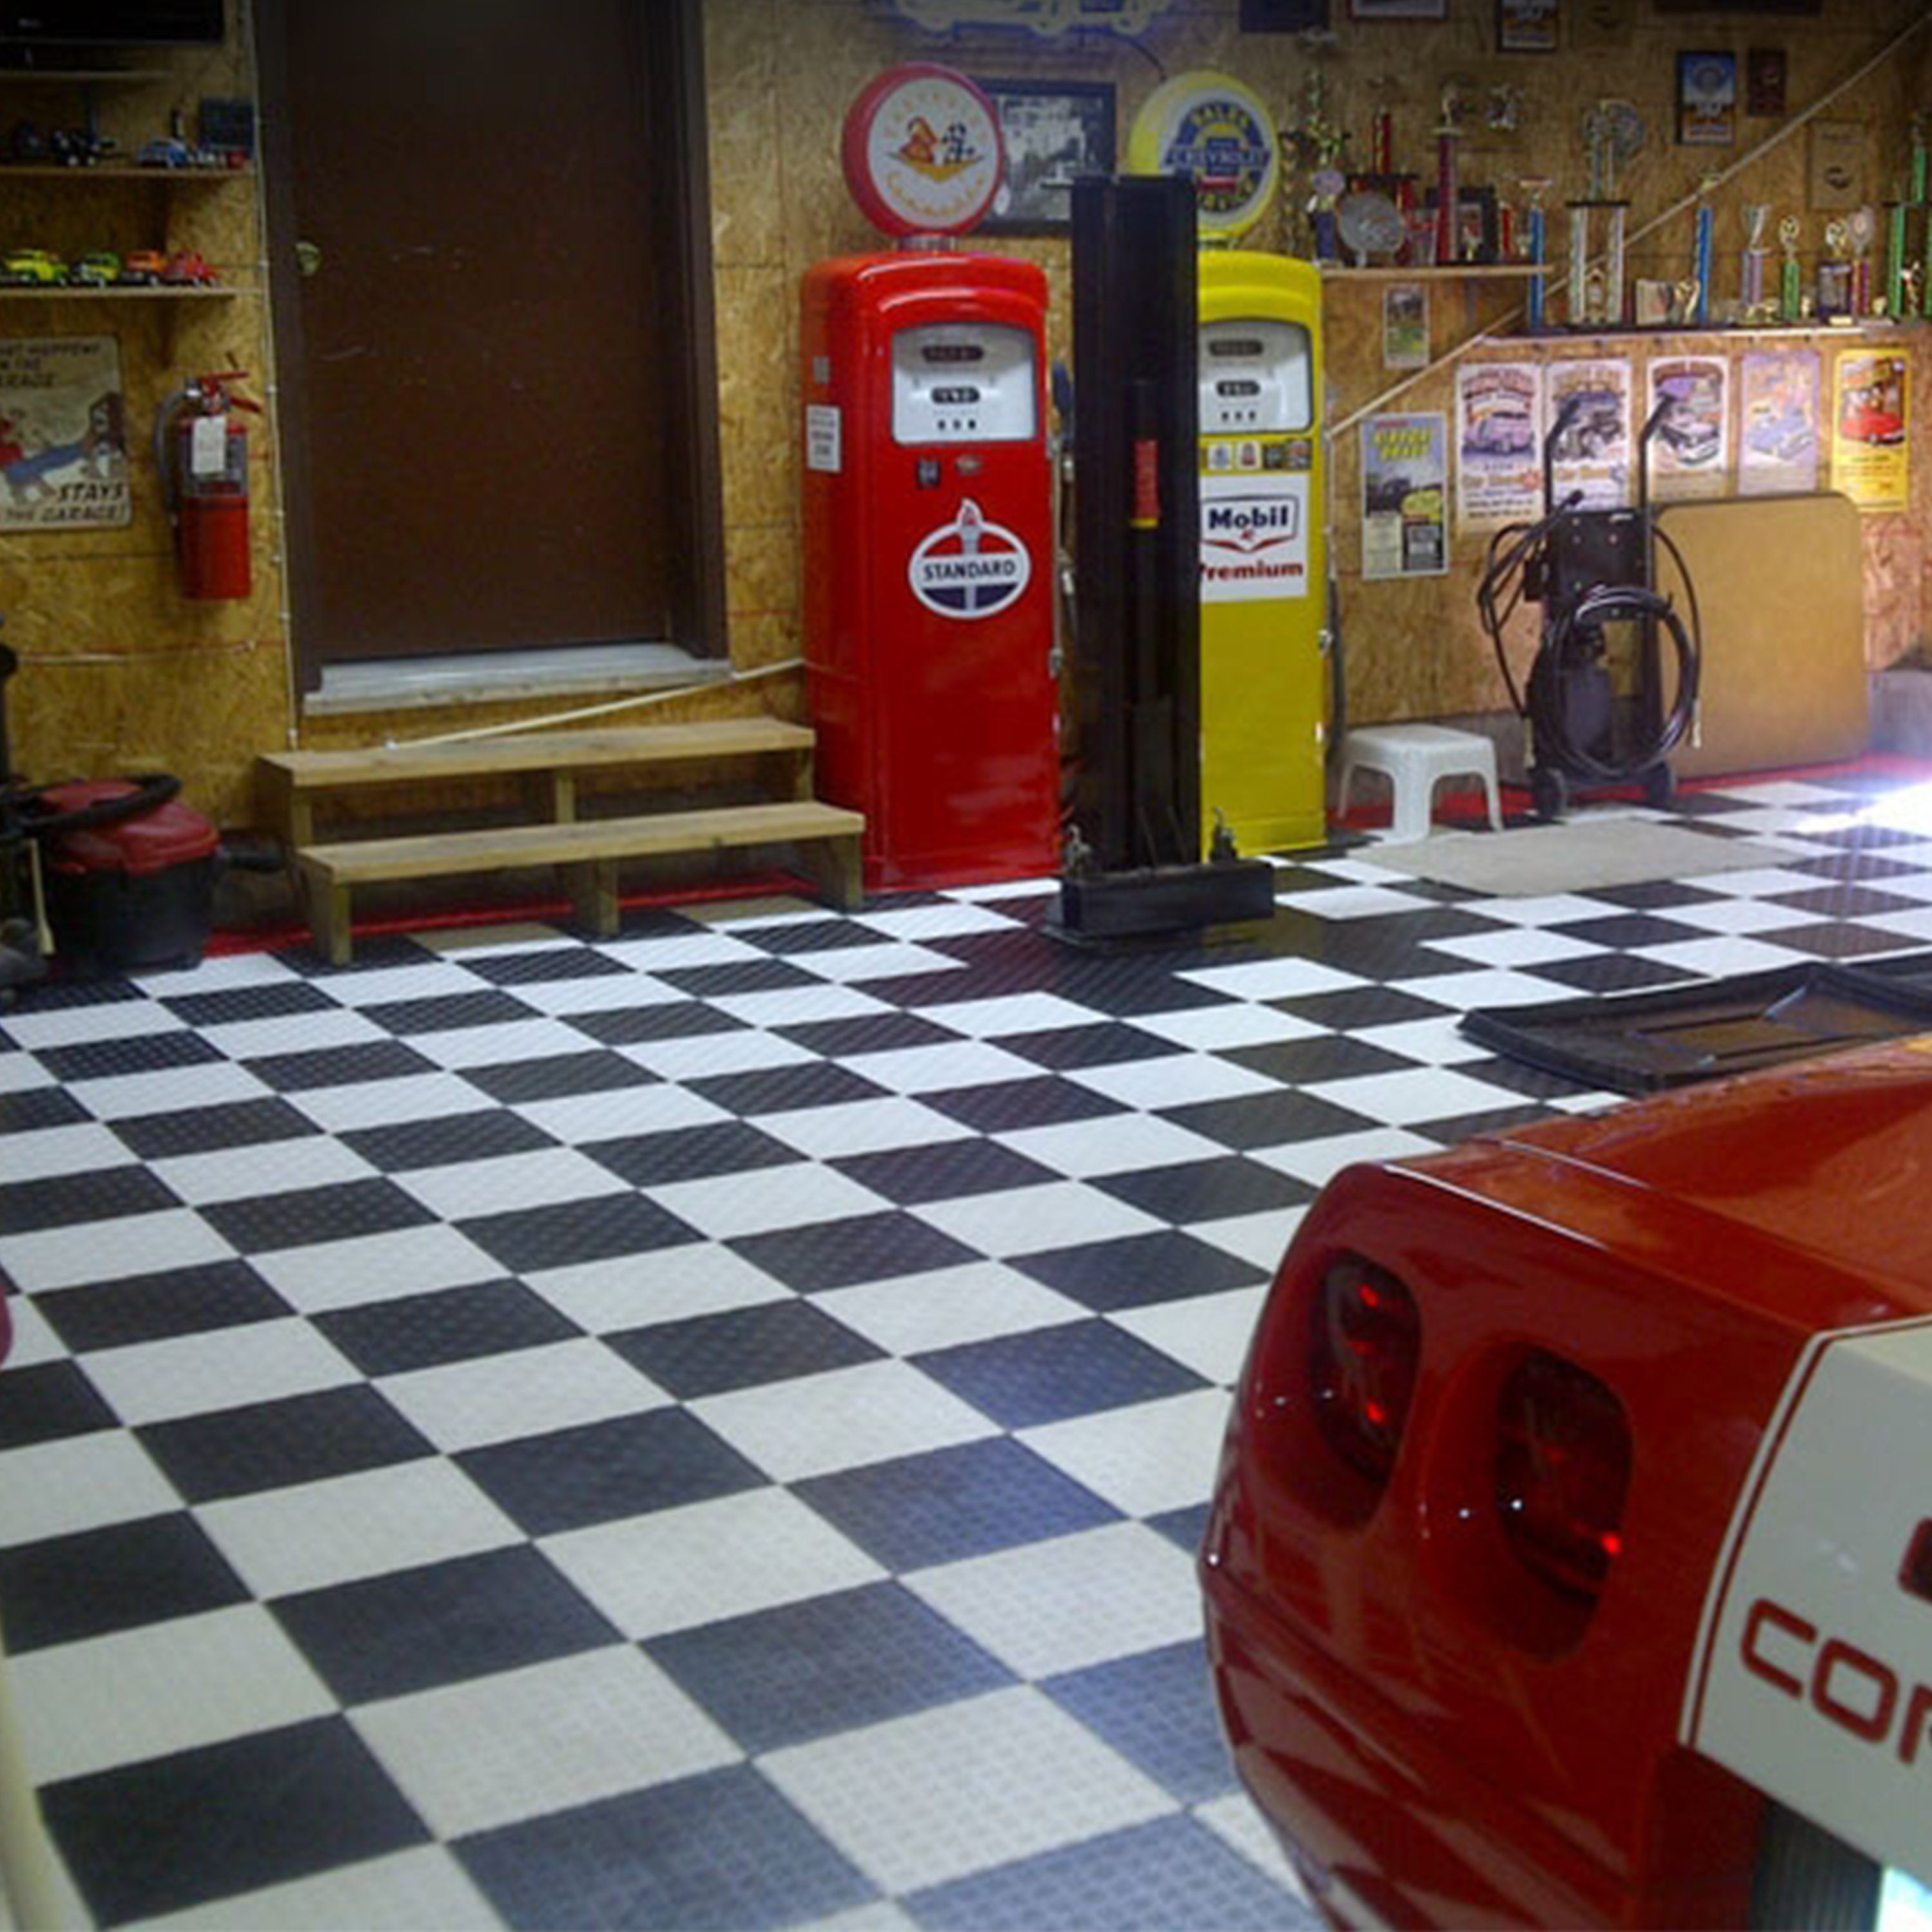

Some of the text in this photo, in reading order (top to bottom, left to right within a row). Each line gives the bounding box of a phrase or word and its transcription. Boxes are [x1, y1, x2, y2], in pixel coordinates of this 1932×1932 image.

[59, 483, 125, 503] STAYS
[1208, 505, 1289, 530] Mobil
[923, 559, 1016, 582] STANDARD
